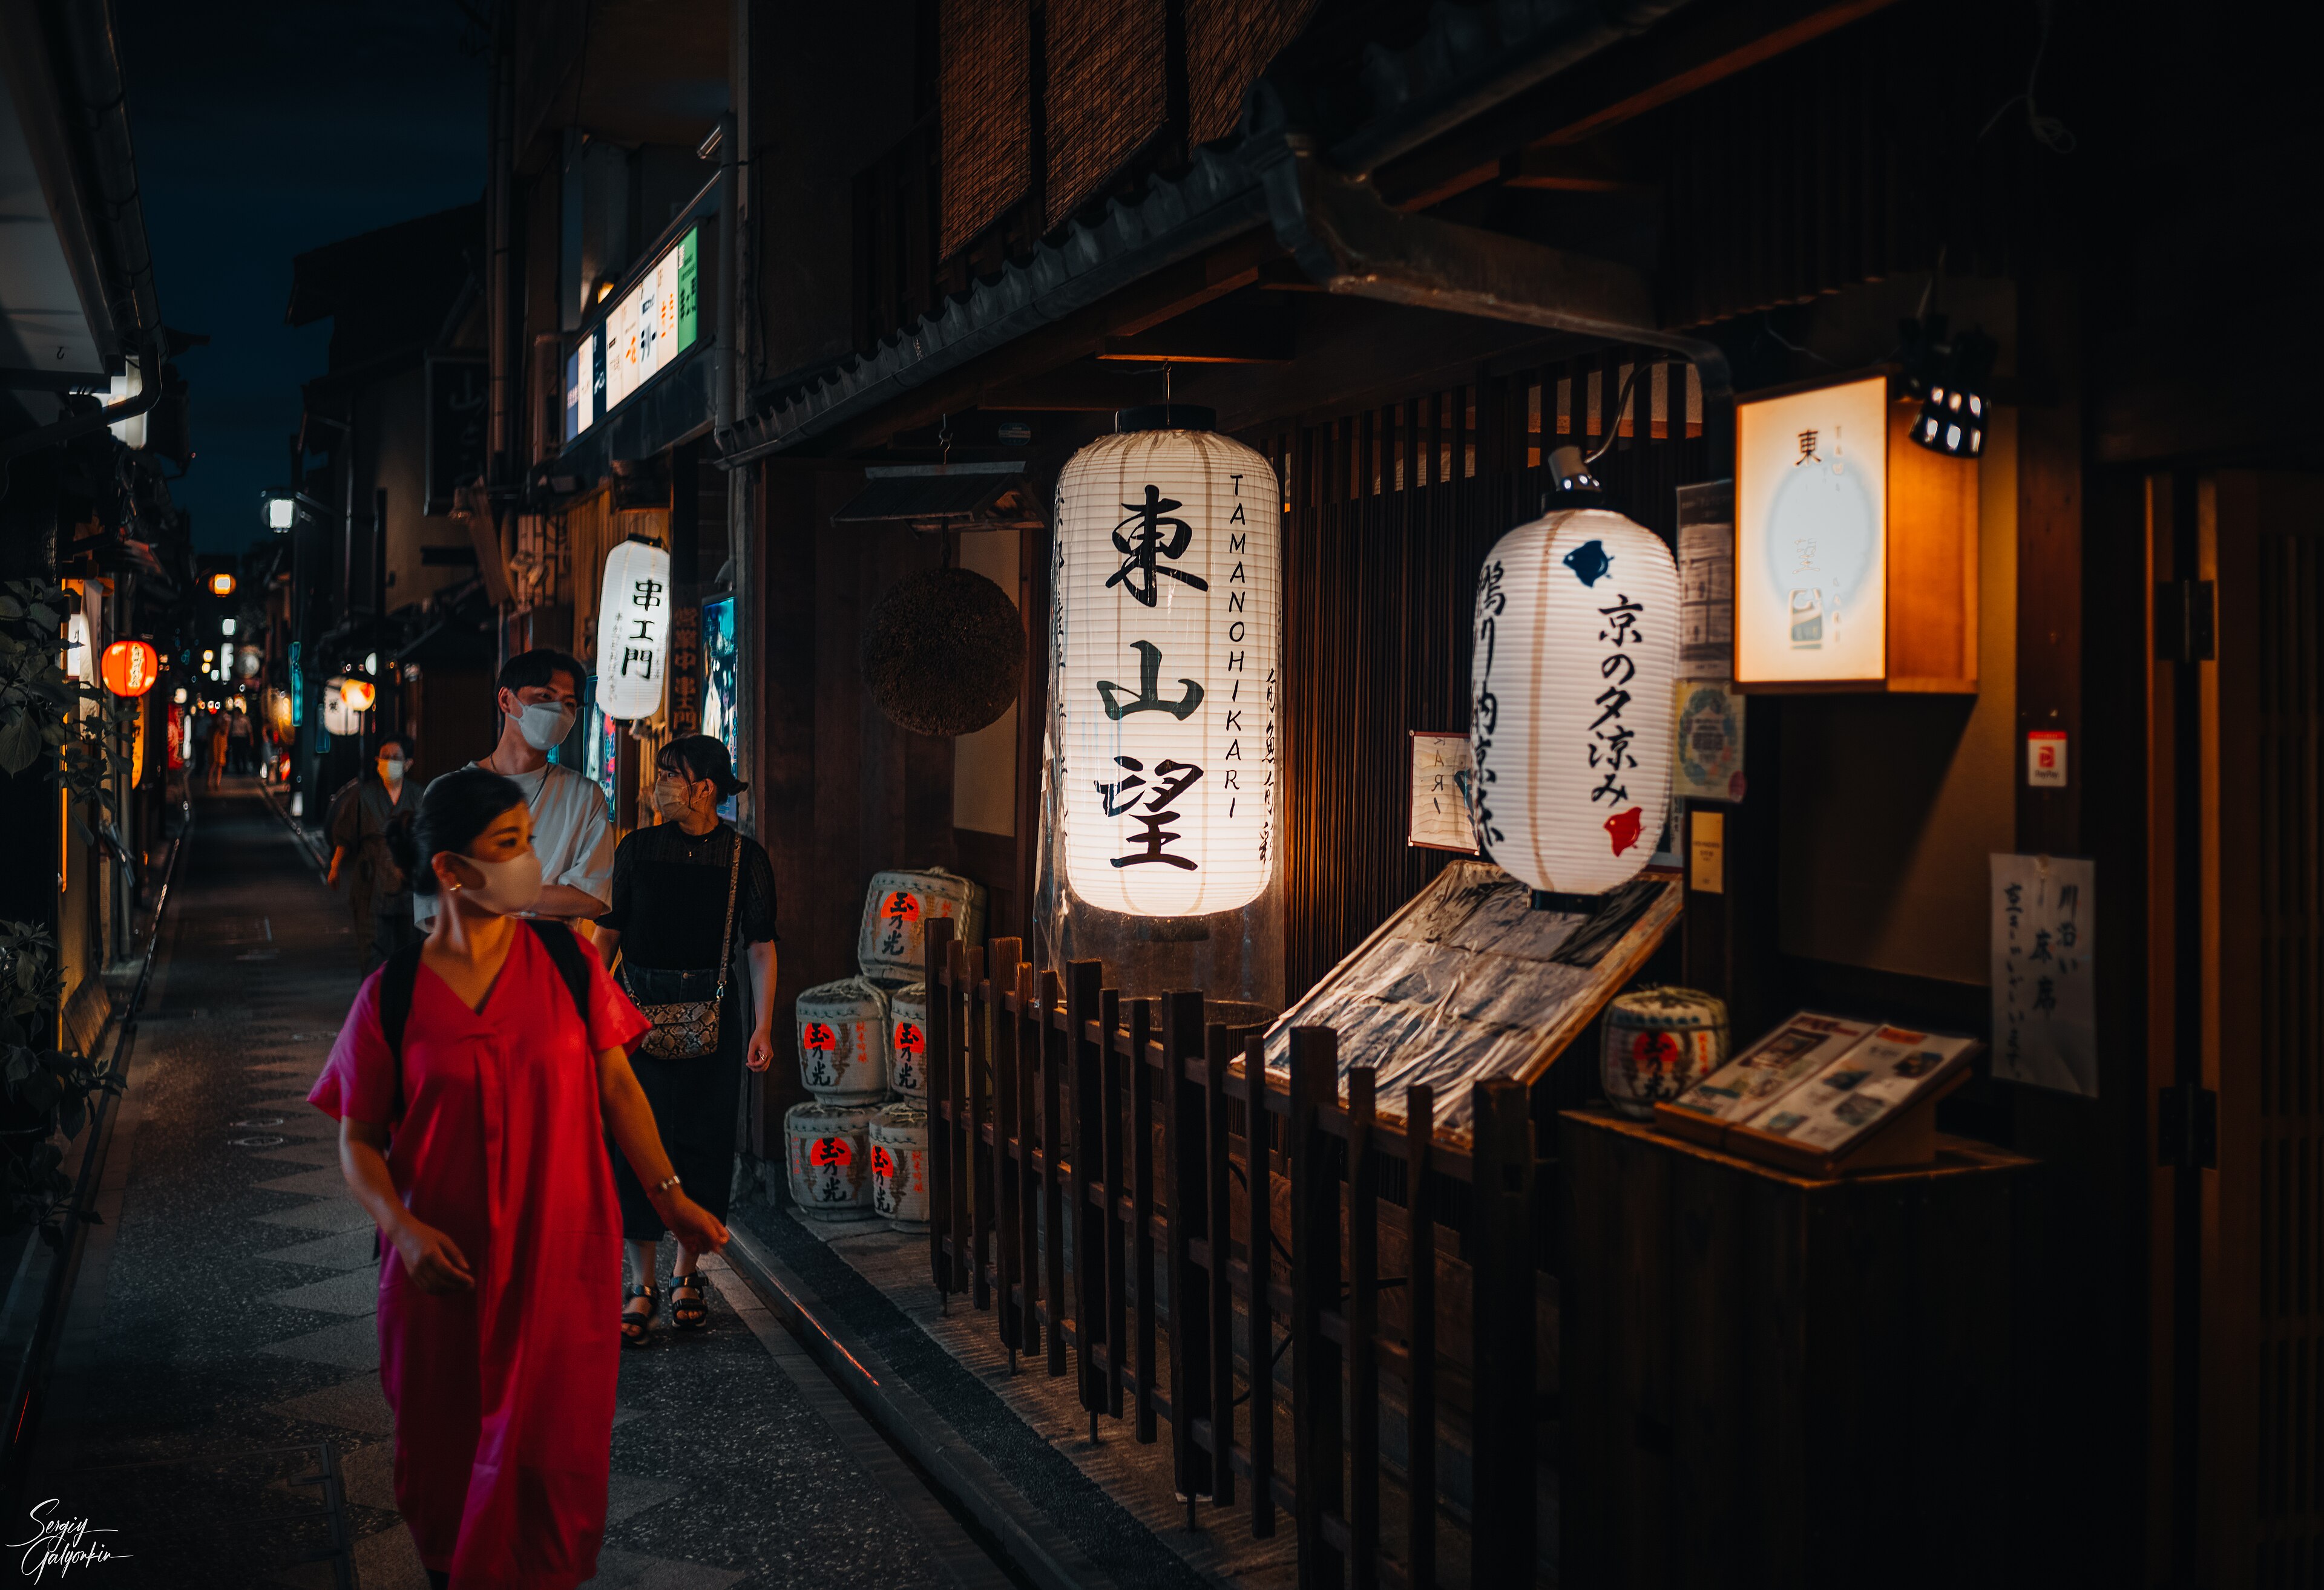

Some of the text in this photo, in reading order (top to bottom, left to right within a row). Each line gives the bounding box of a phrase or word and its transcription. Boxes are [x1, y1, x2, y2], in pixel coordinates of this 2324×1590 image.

[1094, 484, 1209, 871] 東山望
[1224, 474, 1246, 819] TAMANOHIKARI
[1587, 594, 1644, 808] 京の夕涼み
[2035, 770, 2059, 779] PayPay
[882, 892, 914, 955] 玉乃光
[810, 1023, 830, 1086] 玉乃光
[899, 1022, 919, 1088] 玉乃光
[820, 1138, 847, 1202] 玉乃光
[874, 1146, 890, 1212] 玉乃光
